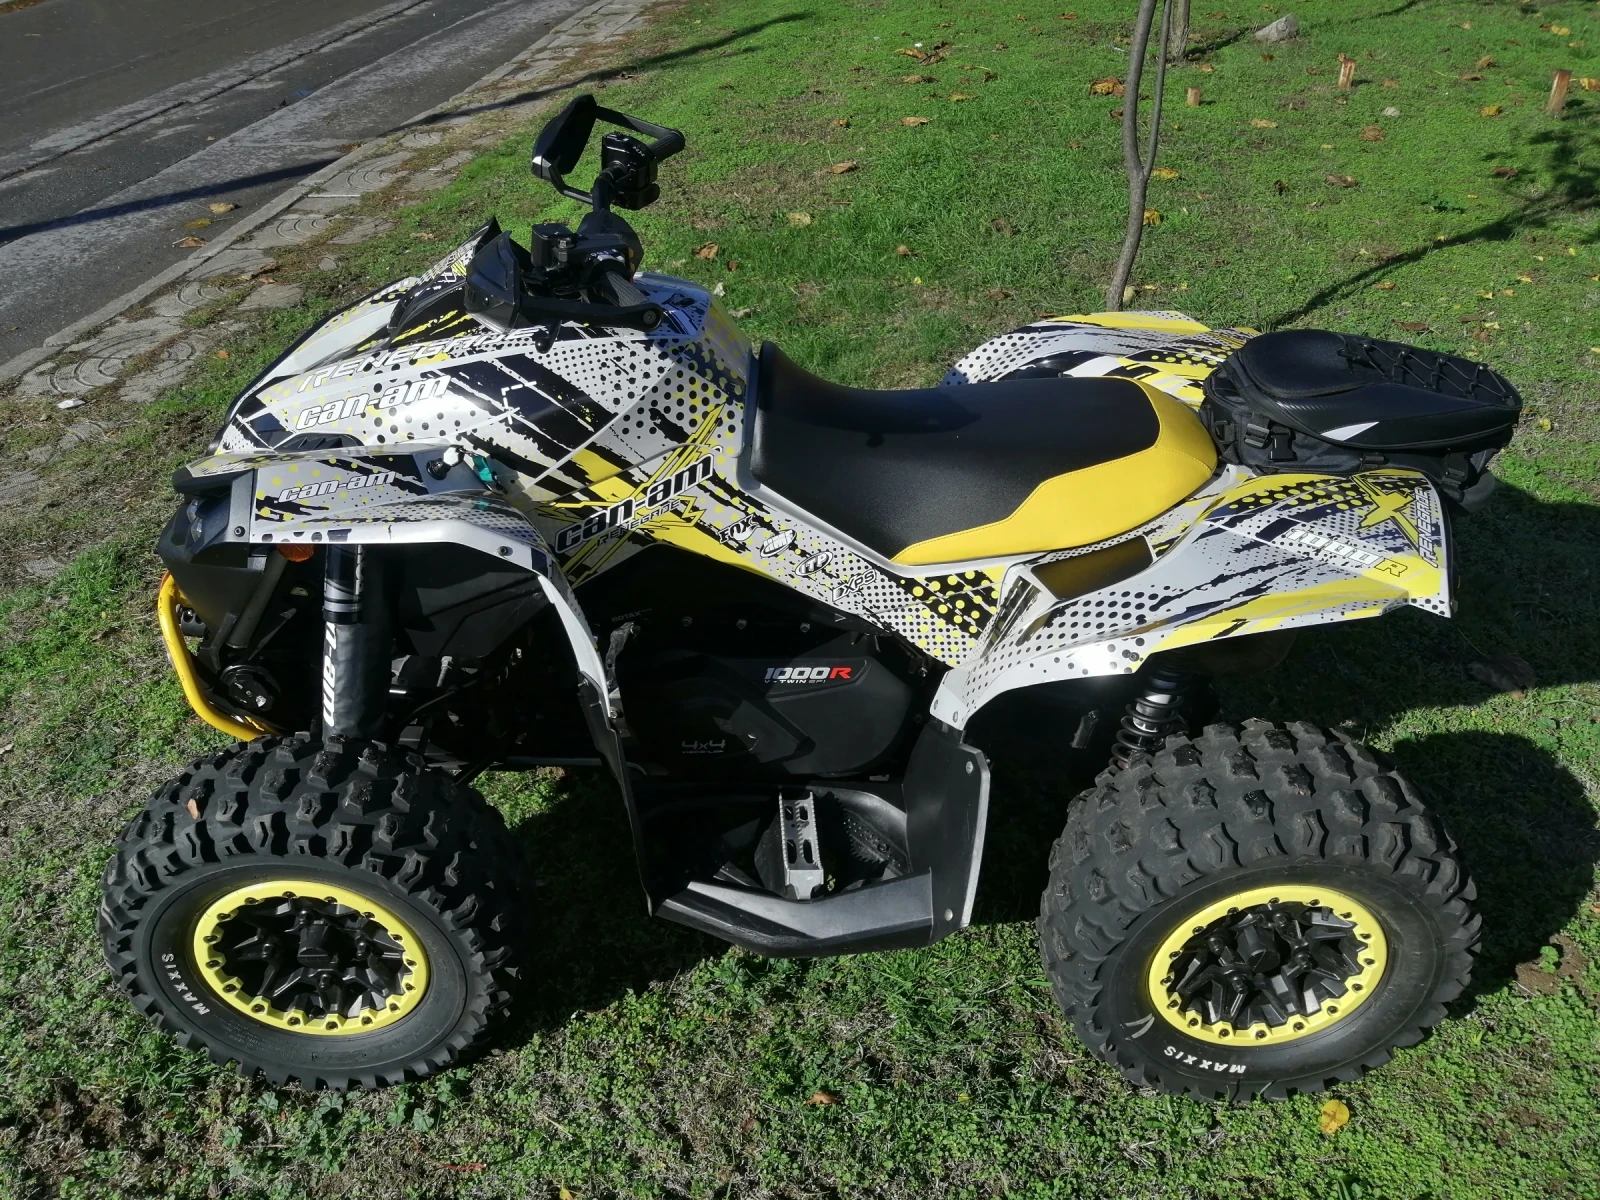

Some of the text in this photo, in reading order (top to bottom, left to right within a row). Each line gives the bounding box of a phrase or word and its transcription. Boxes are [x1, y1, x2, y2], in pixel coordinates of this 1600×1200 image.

[296, 375, 451, 430] can-am
[278, 471, 396, 503] can-am
[555, 453, 714, 553] can-am
[595, 499, 681, 547] RENEGADE
[1415, 486, 1439, 569] RENEGADE
[1285, 528, 1408, 577] 1000R
[611, 610, 641, 622] ROTAX
[764, 667, 852, 680] 1000R
[681, 739, 726, 750] 4x4
[161, 953, 211, 1016] MAXXIS
[1163, 1045, 1247, 1074] MAXXIS
